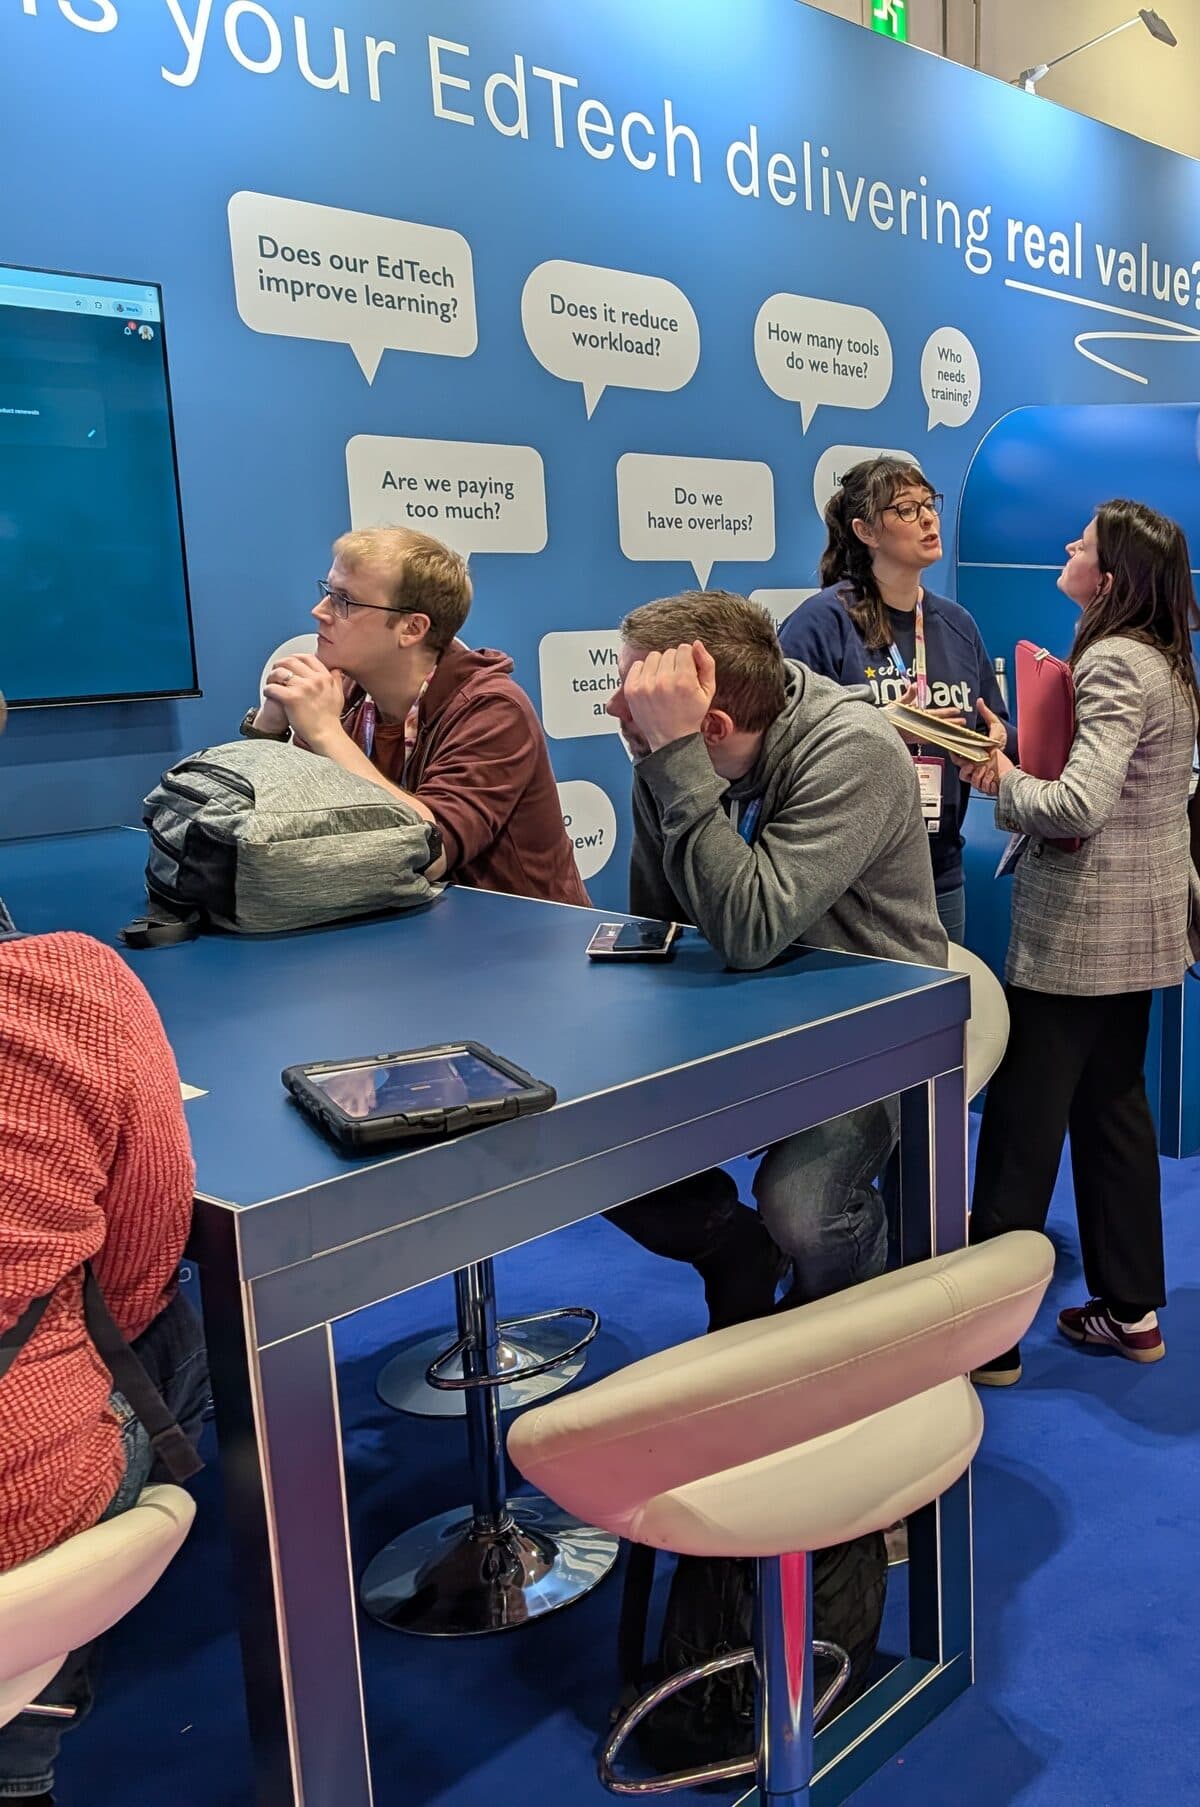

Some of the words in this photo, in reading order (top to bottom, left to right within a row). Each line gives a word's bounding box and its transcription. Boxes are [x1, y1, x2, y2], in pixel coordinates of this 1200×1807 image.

[162, 0, 395, 101] your
[429, 36, 701, 183] EdTech
[727, 125, 992, 274] delivering
[1008, 219, 1081, 278] real
[259, 235, 321, 266] Does
[330, 255, 369, 273] our
[377, 256, 454, 288] EdTech
[260, 275, 357, 303] improve
[365, 285, 458, 321] learning?
[551, 294, 597, 320] Does
[604, 303, 616, 323] it
[622, 309, 677, 332] reduce
[572, 332, 660, 356] workload?
[768, 322, 801, 344] How
[807, 334, 843, 355] many
[848, 339, 879, 356] tools
[787, 351, 803, 369] do
[809, 360, 828, 373] we
[833, 358, 867, 378] have?
[938, 347, 961, 363] Who
[938, 370, 965, 383] needs
[932, 388, 971, 407] training?
[382, 471, 417, 490] Are
[424, 479, 451, 492] we
[458, 477, 514, 500] paying
[675, 488, 696, 504] Do
[702, 494, 722, 505] we
[406, 503, 438, 517] too
[446, 502, 500, 519] much?
[648, 511, 682, 529] have
[688, 514, 752, 535] overlaps?
[589, 649, 619, 665] Wh
[573, 672, 622, 692] teache
[575, 829, 604, 848] ew?
